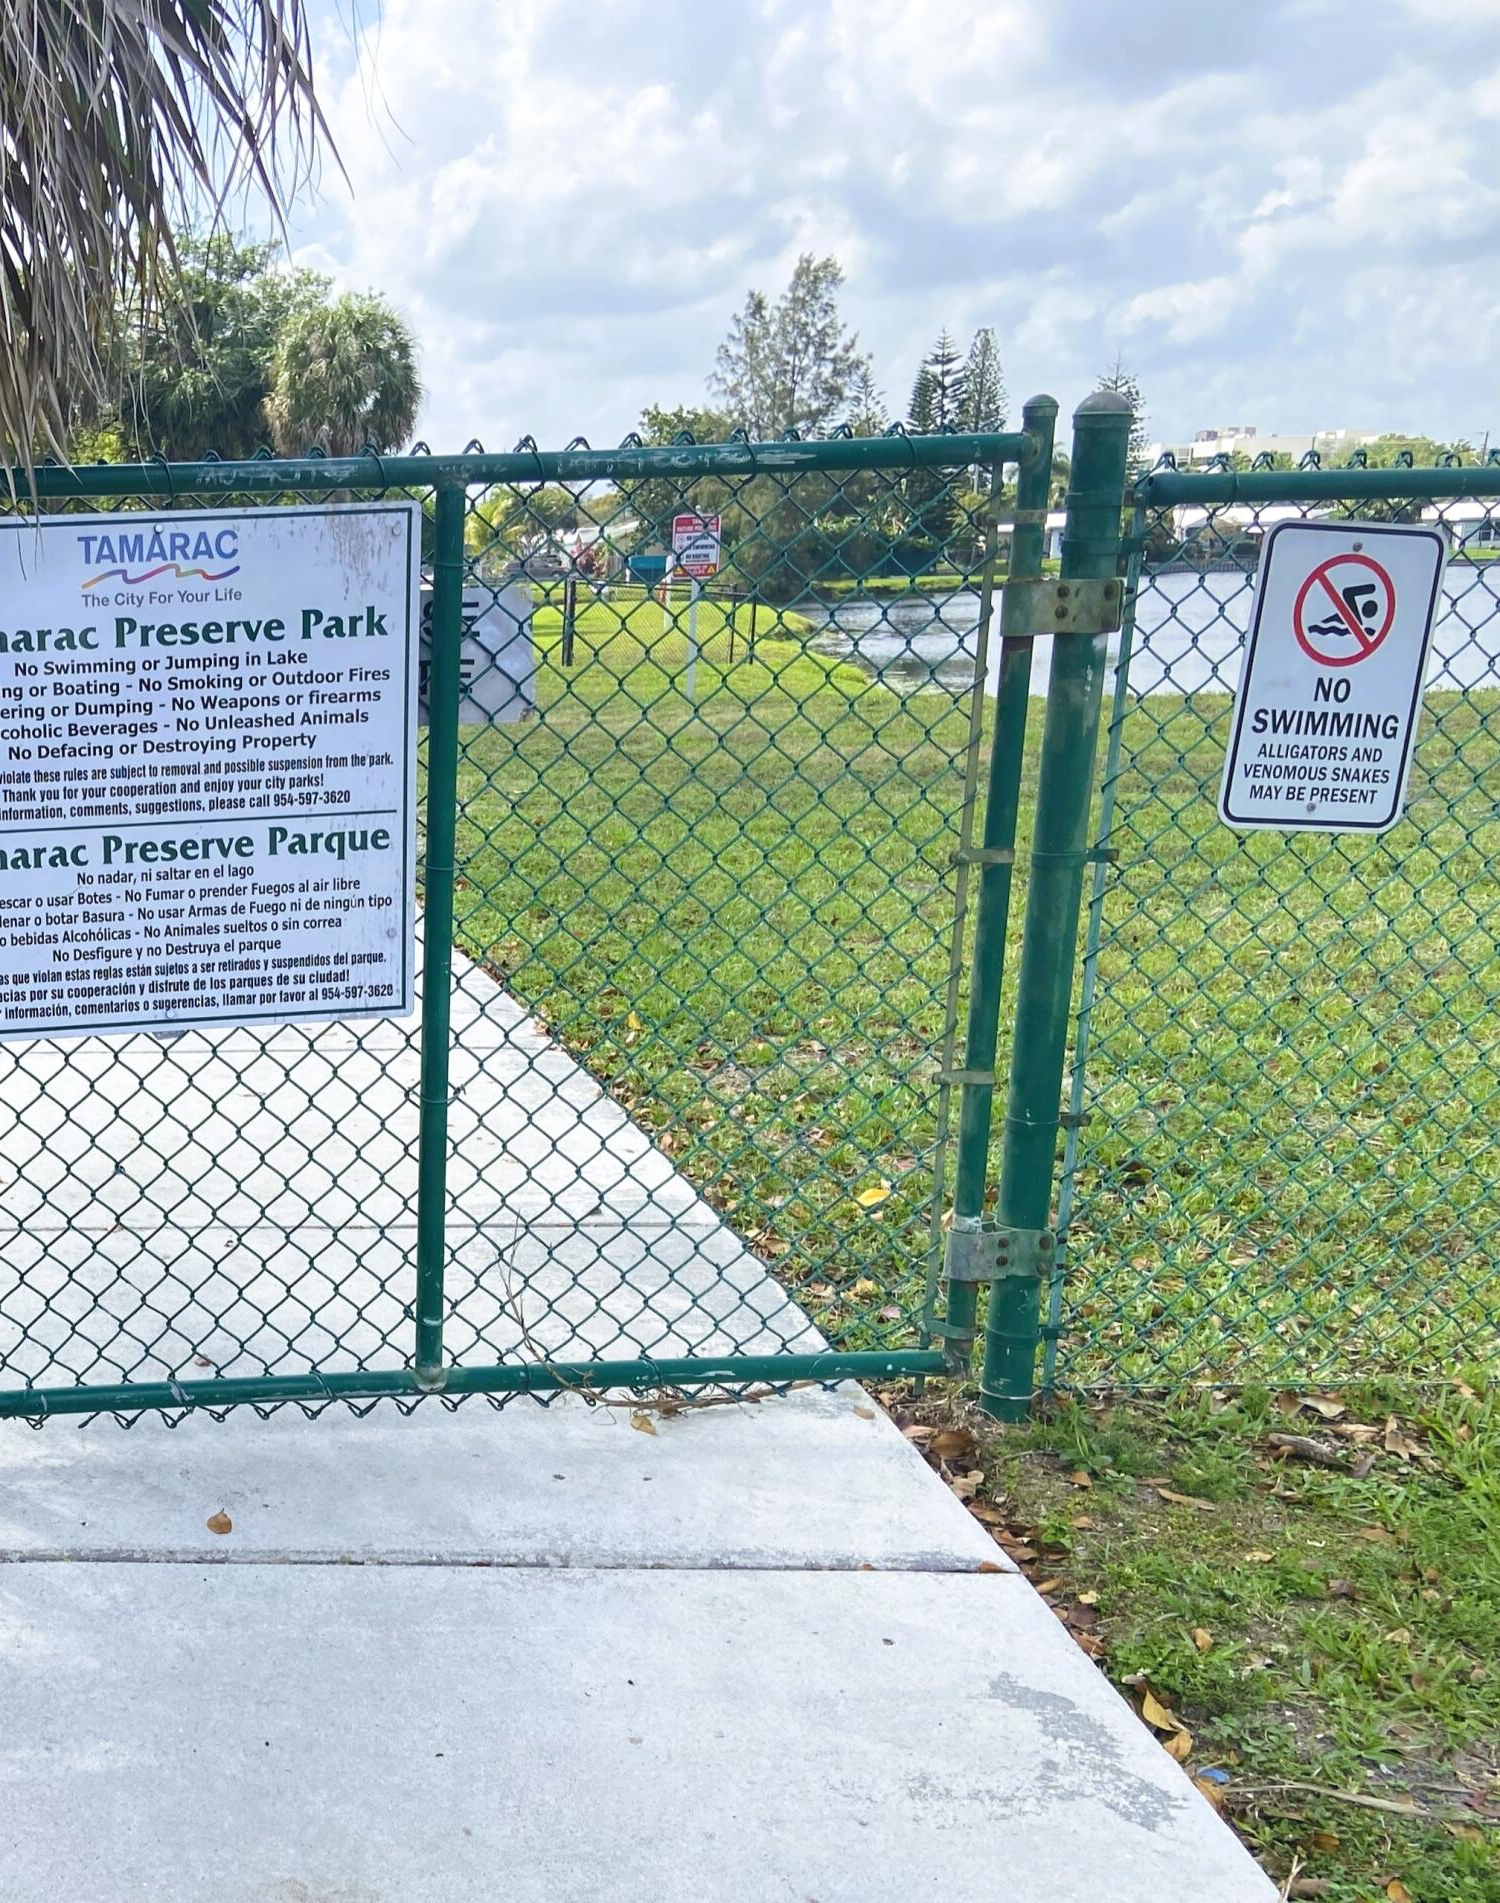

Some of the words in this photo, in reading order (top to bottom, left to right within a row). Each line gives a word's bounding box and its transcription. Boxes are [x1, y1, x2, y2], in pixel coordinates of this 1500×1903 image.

[76, 529, 239, 565] TAMARAC
[81, 594, 110, 607] The
[114, 592, 144, 608] City
[149, 591, 174, 605] For
[177, 590, 210, 603] Your
[215, 588, 242, 602] Life
[115, 617, 285, 648] Preserve
[301, 605, 388, 640] Park
[14, 662, 38, 677] No
[43, 657, 136, 676] Swimming
[141, 659, 161, 671] or
[165, 652, 240, 672] Jumping
[245, 654, 261, 667] in
[267, 649, 308, 665] Lake
[1313, 677, 1351, 703] NO
[1251, 708, 1399, 739] SWIMMING
[8, 746, 32, 761] No
[37, 742, 113, 759] Defacing
[119, 743, 138, 755] or
[143, 736, 236, 755] Destroying
[242, 732, 317, 751] Property
[1257, 743, 1348, 761] ALLIGATORS
[1351, 747, 1383, 763] AND
[33, 769, 61, 783] these
[63, 767, 89, 782] rules
[91, 768, 107, 780] are
[110, 764, 146, 780] subject
[148, 764, 158, 778] to
[161, 761, 201, 777] removal
[203, 760, 222, 775] and
[224, 758, 265, 776] possible
[268, 756, 323, 772] suspension
[325, 754, 348, 768] from
[350, 753, 366, 768] the
[369, 752, 394, 768] park.
[1243, 763, 1327, 781] VENOMOUS
[1331, 768, 1390, 784] SNAKES
[2, 787, 37, 803] Thank
[39, 789, 60, 803] you
[62, 786, 79, 800] for
[81, 787, 107, 801] your
[109, 781, 177, 798] cooperation
[180, 779, 201, 794] and
[204, 778, 235, 794] enjoy
[237, 779, 262, 793] your
[265, 775, 286, 791] city
[289, 773, 324, 790] parks!
[1249, 785, 1282, 800] MAY
[1285, 786, 1305, 801] BE
[1309, 788, 1378, 804] PRESENT
[70, 802, 132, 818] comments,
[135, 798, 205, 815] suggestions,
[208, 796, 246, 812] please
[249, 793, 270, 808] call
[273, 789, 351, 807] 954-597-3620
[103, 835, 254, 865] Preserve
[269, 828, 390, 861] Parque
[52, 949, 70, 962] No
[73, 946, 133, 963] Desfigure
[135, 947, 143, 961] y
[146, 946, 162, 957] no
[165, 942, 220, 957] Destruya
[224, 938, 235, 952] el
[238, 939, 282, 955] parque
